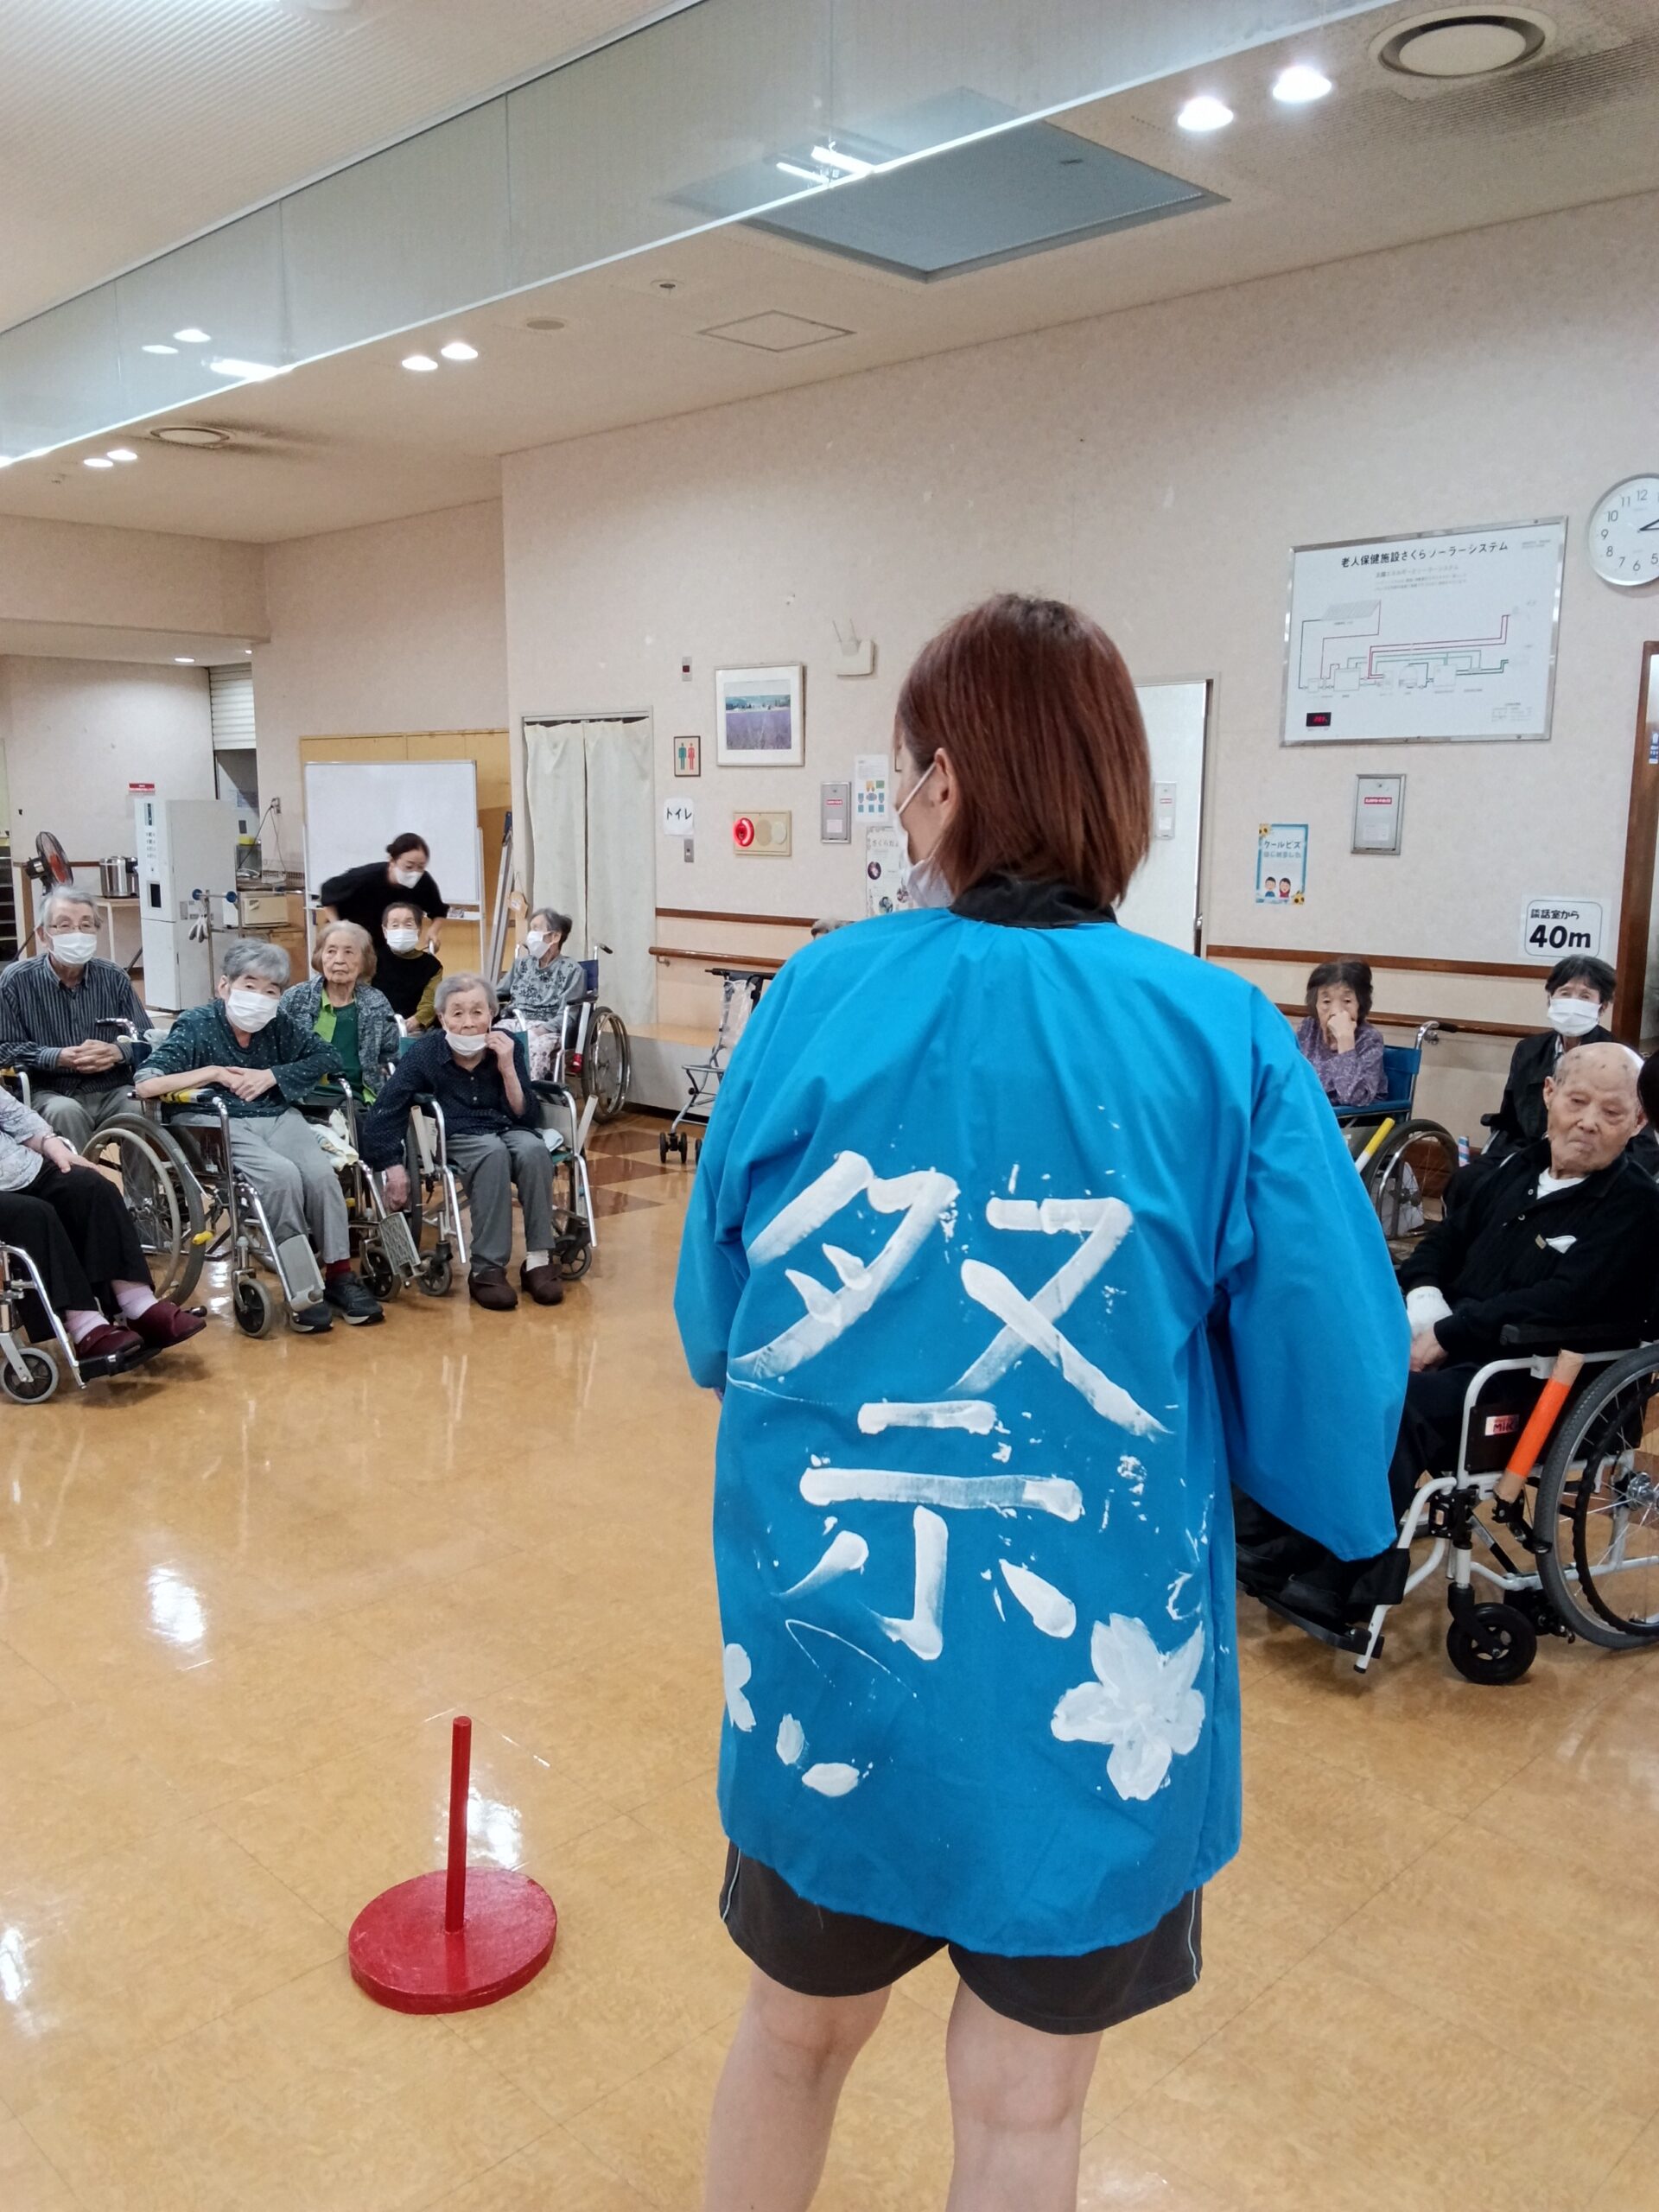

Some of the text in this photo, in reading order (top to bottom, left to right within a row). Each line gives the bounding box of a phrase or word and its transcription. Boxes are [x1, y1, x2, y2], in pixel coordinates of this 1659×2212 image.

[1637, 489, 1649, 501] 12
[1621, 496, 1631, 508] 11
[1607, 510, 1618, 523] 10
[1600, 528, 1609, 540] 9
[1605, 545, 1614, 557] 8
[1618, 556, 1626, 569] 7
[1650, 552, 1659, 565] 5
[1632, 560, 1642, 572] 6
[665, 807, 693, 821] トイレ
[1530, 908, 1580, 920] 談話室から
[1529, 924, 1592, 950] 40m
